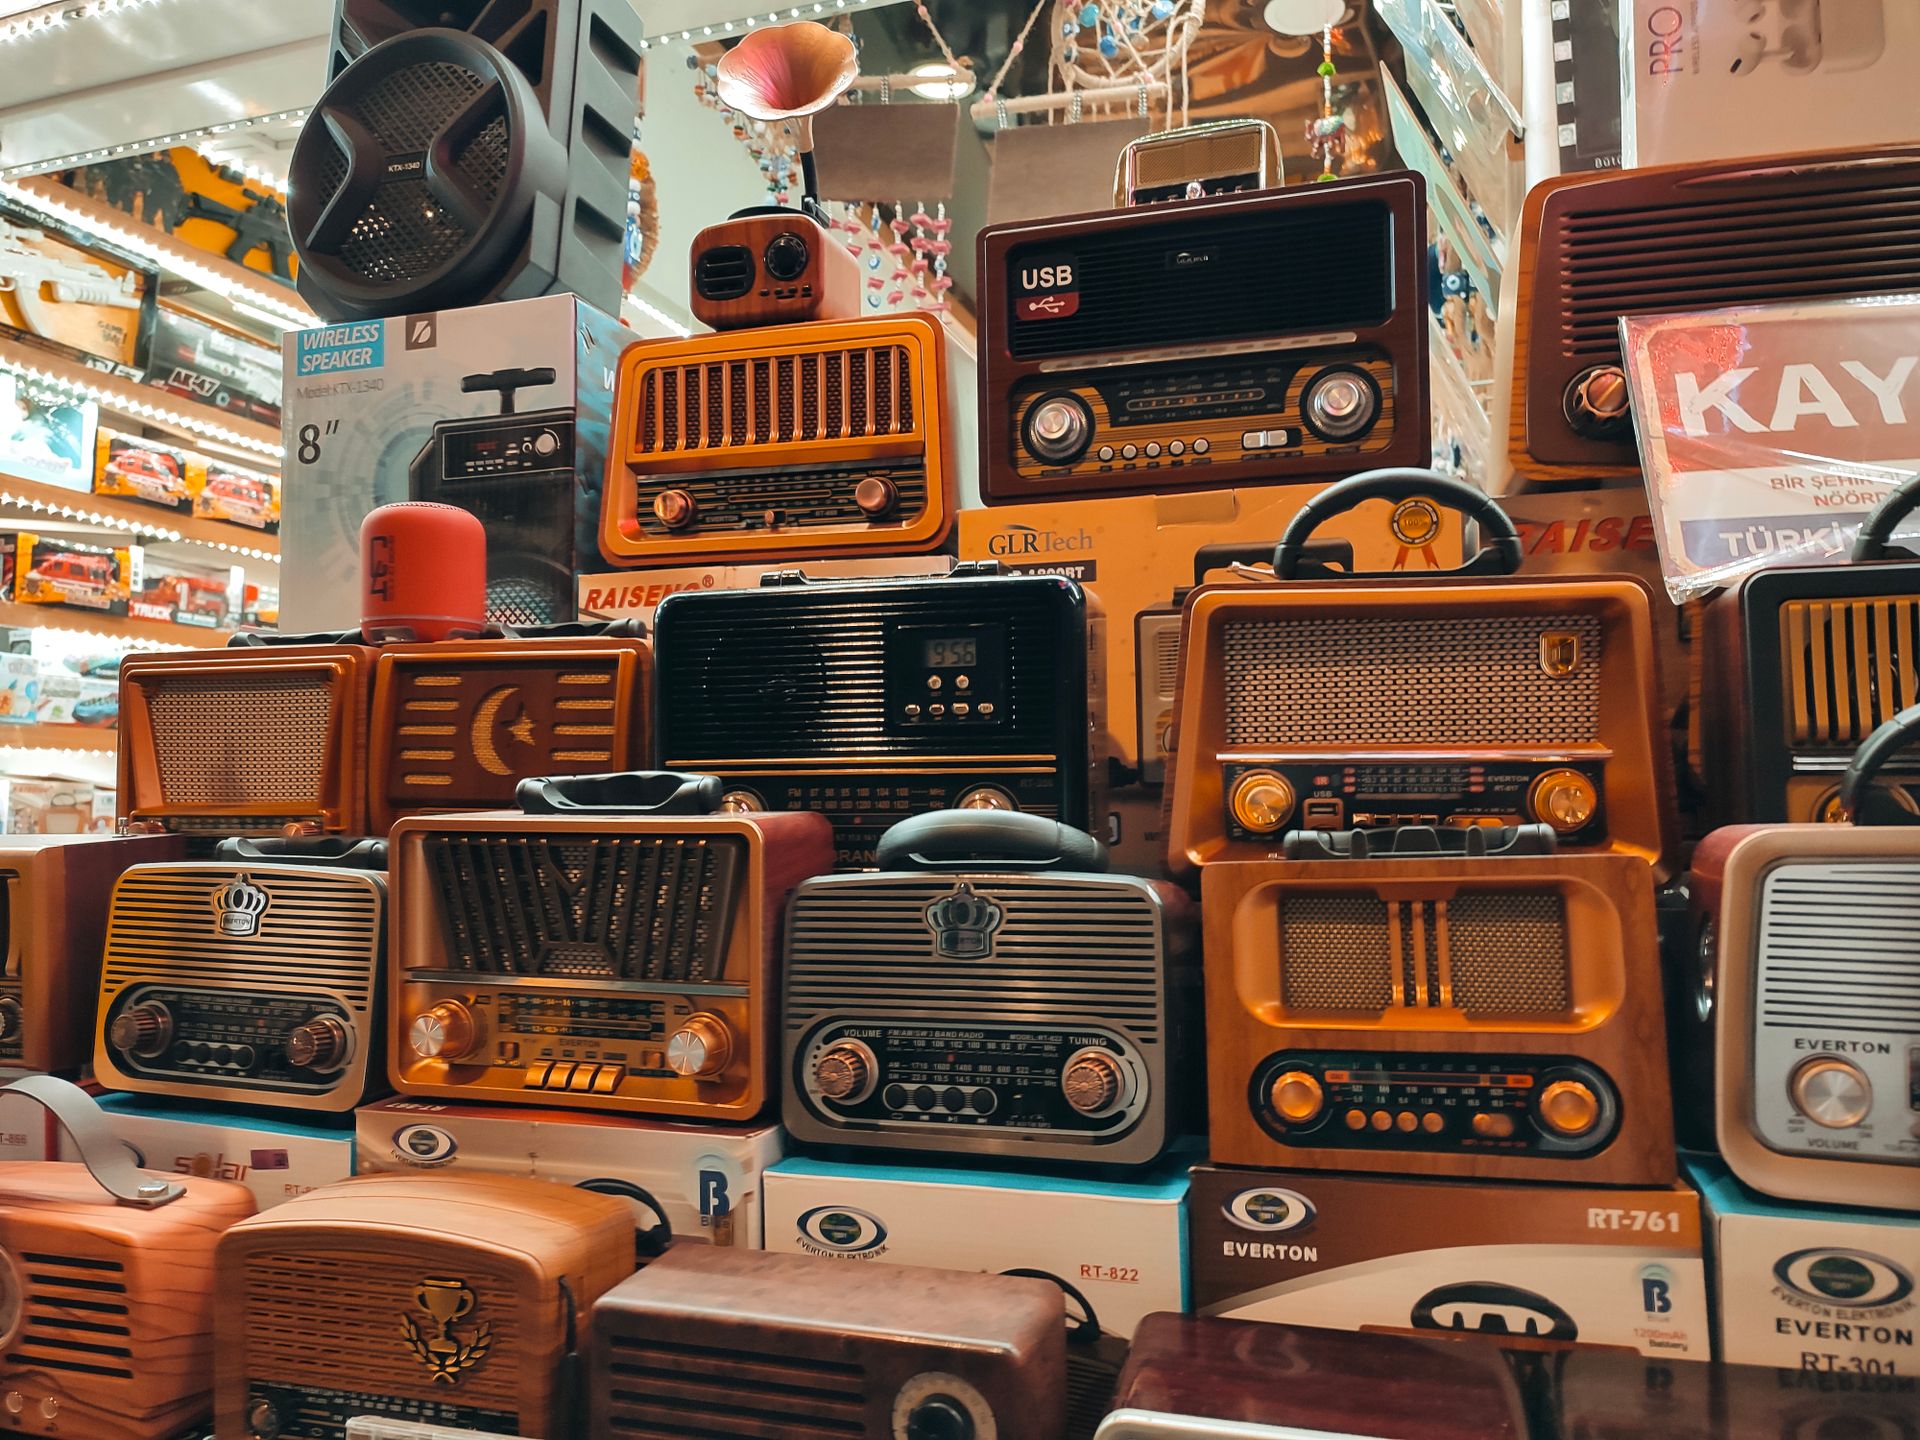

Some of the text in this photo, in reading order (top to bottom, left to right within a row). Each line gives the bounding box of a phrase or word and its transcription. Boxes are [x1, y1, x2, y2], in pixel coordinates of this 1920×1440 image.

[1648, 7, 1684, 75] PRO
[1021, 264, 1073, 290] USB
[302, 323, 380, 350] WIRELESS
[301, 347, 372, 373] SPEAKER
[1770, 475, 1805, 489] BİR
[1488, 775, 1529, 783] EVERTON
[788, 787, 801, 797] FM
[1313, 790, 1333, 798] USB
[844, 1028, 882, 1038] VOLUME
[958, 1031, 984, 1039] RADIO
[1069, 1036, 1107, 1046] TUNING
[1794, 1037, 1891, 1054] EVERTON
[1807, 1137, 1860, 1150] VOLUME
[1587, 1207, 1680, 1233] RT-761
[1223, 1241, 1317, 1262] EVERTON
[1080, 1263, 1140, 1281] RT-822
[1771, 1286, 1832, 1317] EVERTON
[1633, 1328, 1687, 1340] 1200mAh
[1775, 1316, 1914, 1346] EVERTON
[1649, 1338, 1688, 1352] Battery
[1801, 1351, 1897, 1375] RT-301
